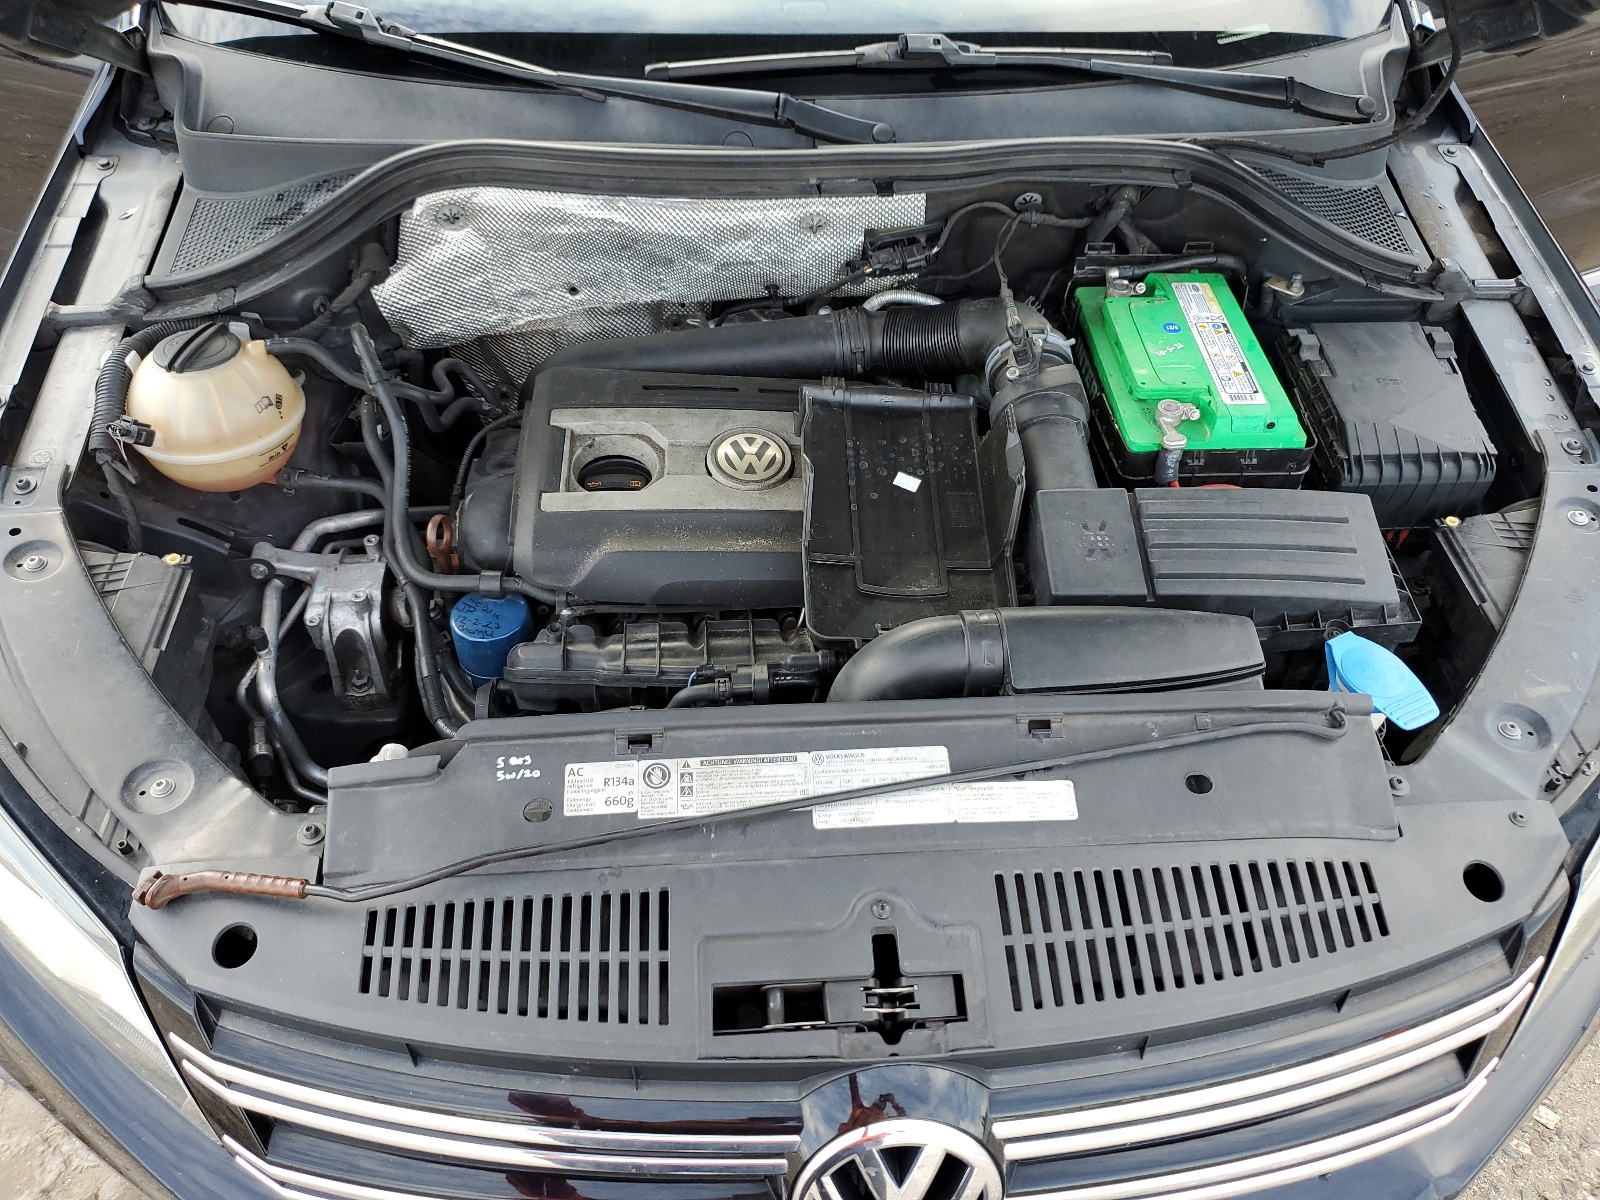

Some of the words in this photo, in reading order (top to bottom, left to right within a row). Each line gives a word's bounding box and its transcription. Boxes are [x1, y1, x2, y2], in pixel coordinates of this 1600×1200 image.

[268, 451, 281, 461] min
[716, 432, 784, 481] VW
[825, 752, 866, 760] VOLKSWAGEN
[567, 767, 585, 777] AC
[603, 776, 635, 787] R134a
[604, 795, 635, 809] 660g
